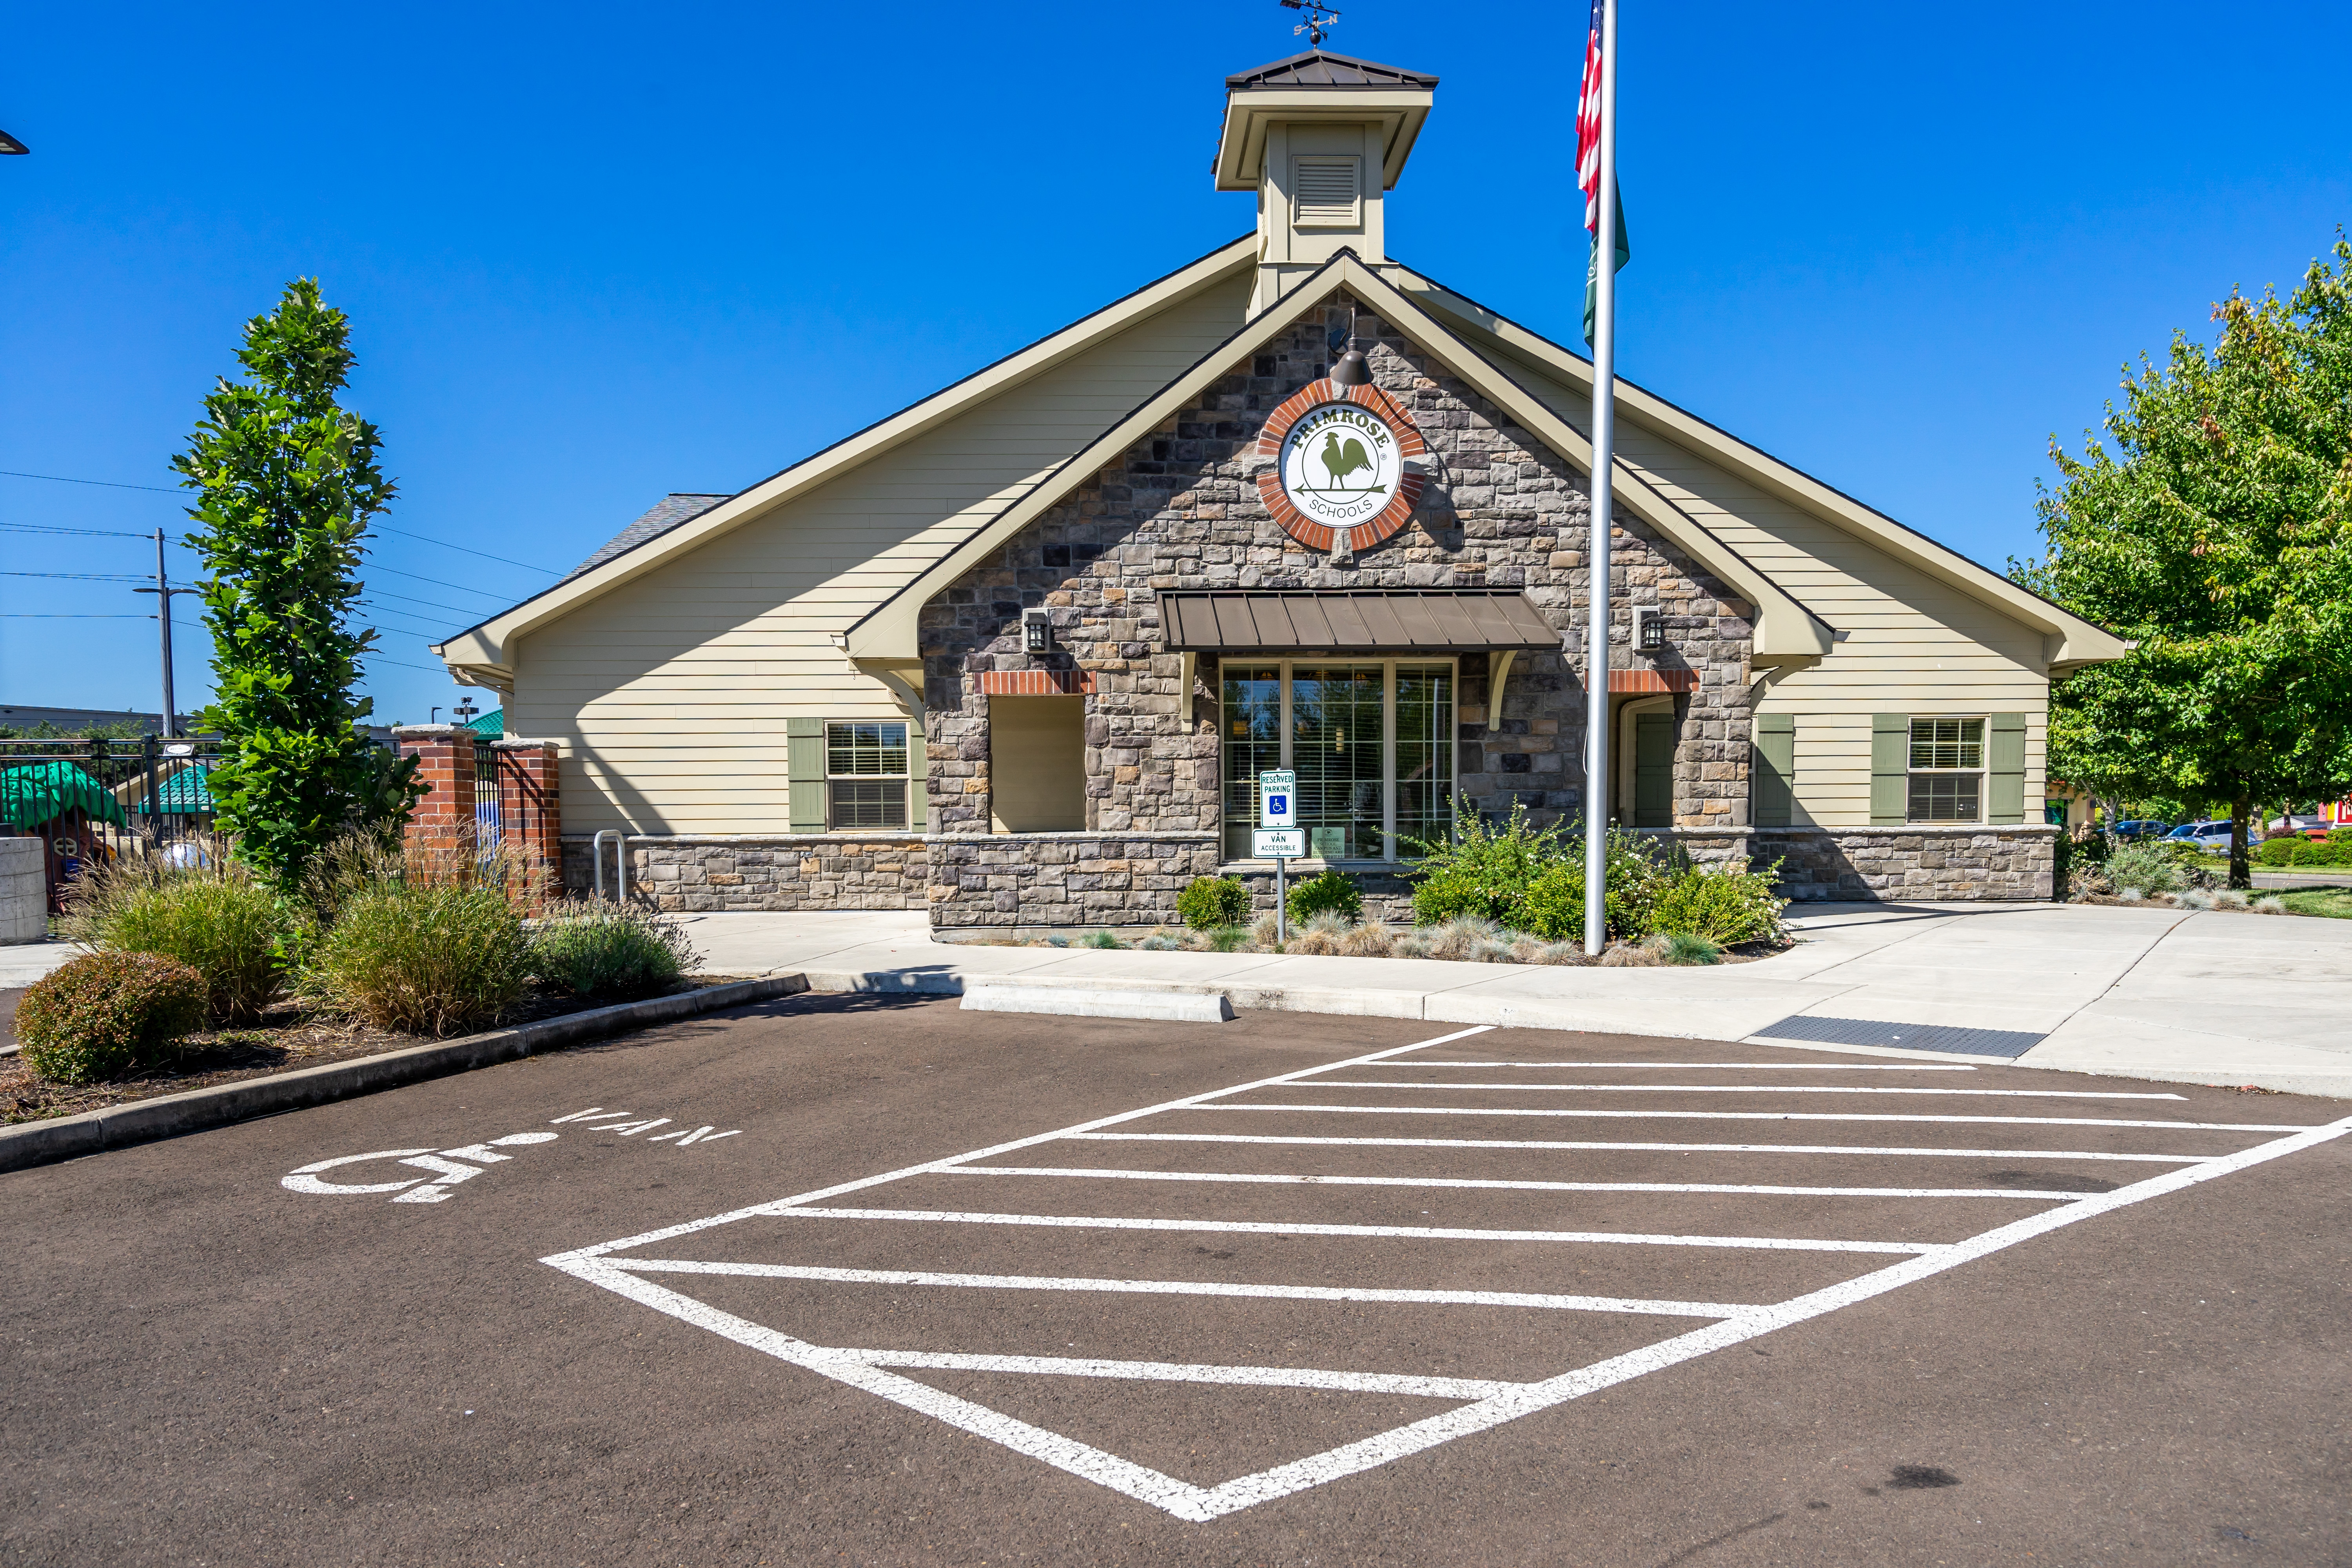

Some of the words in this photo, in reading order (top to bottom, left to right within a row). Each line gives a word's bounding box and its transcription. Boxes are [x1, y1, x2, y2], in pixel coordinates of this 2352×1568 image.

[1329, 14, 1338, 25] N
[1294, 25, 1302, 36] S
[1289, 408, 1390, 449] PRIMROSE
[1309, 499, 1372, 518] SCHOOLS
[1262, 775, 1292, 784] RESERVED
[548, 1107, 743, 1146] VAN
